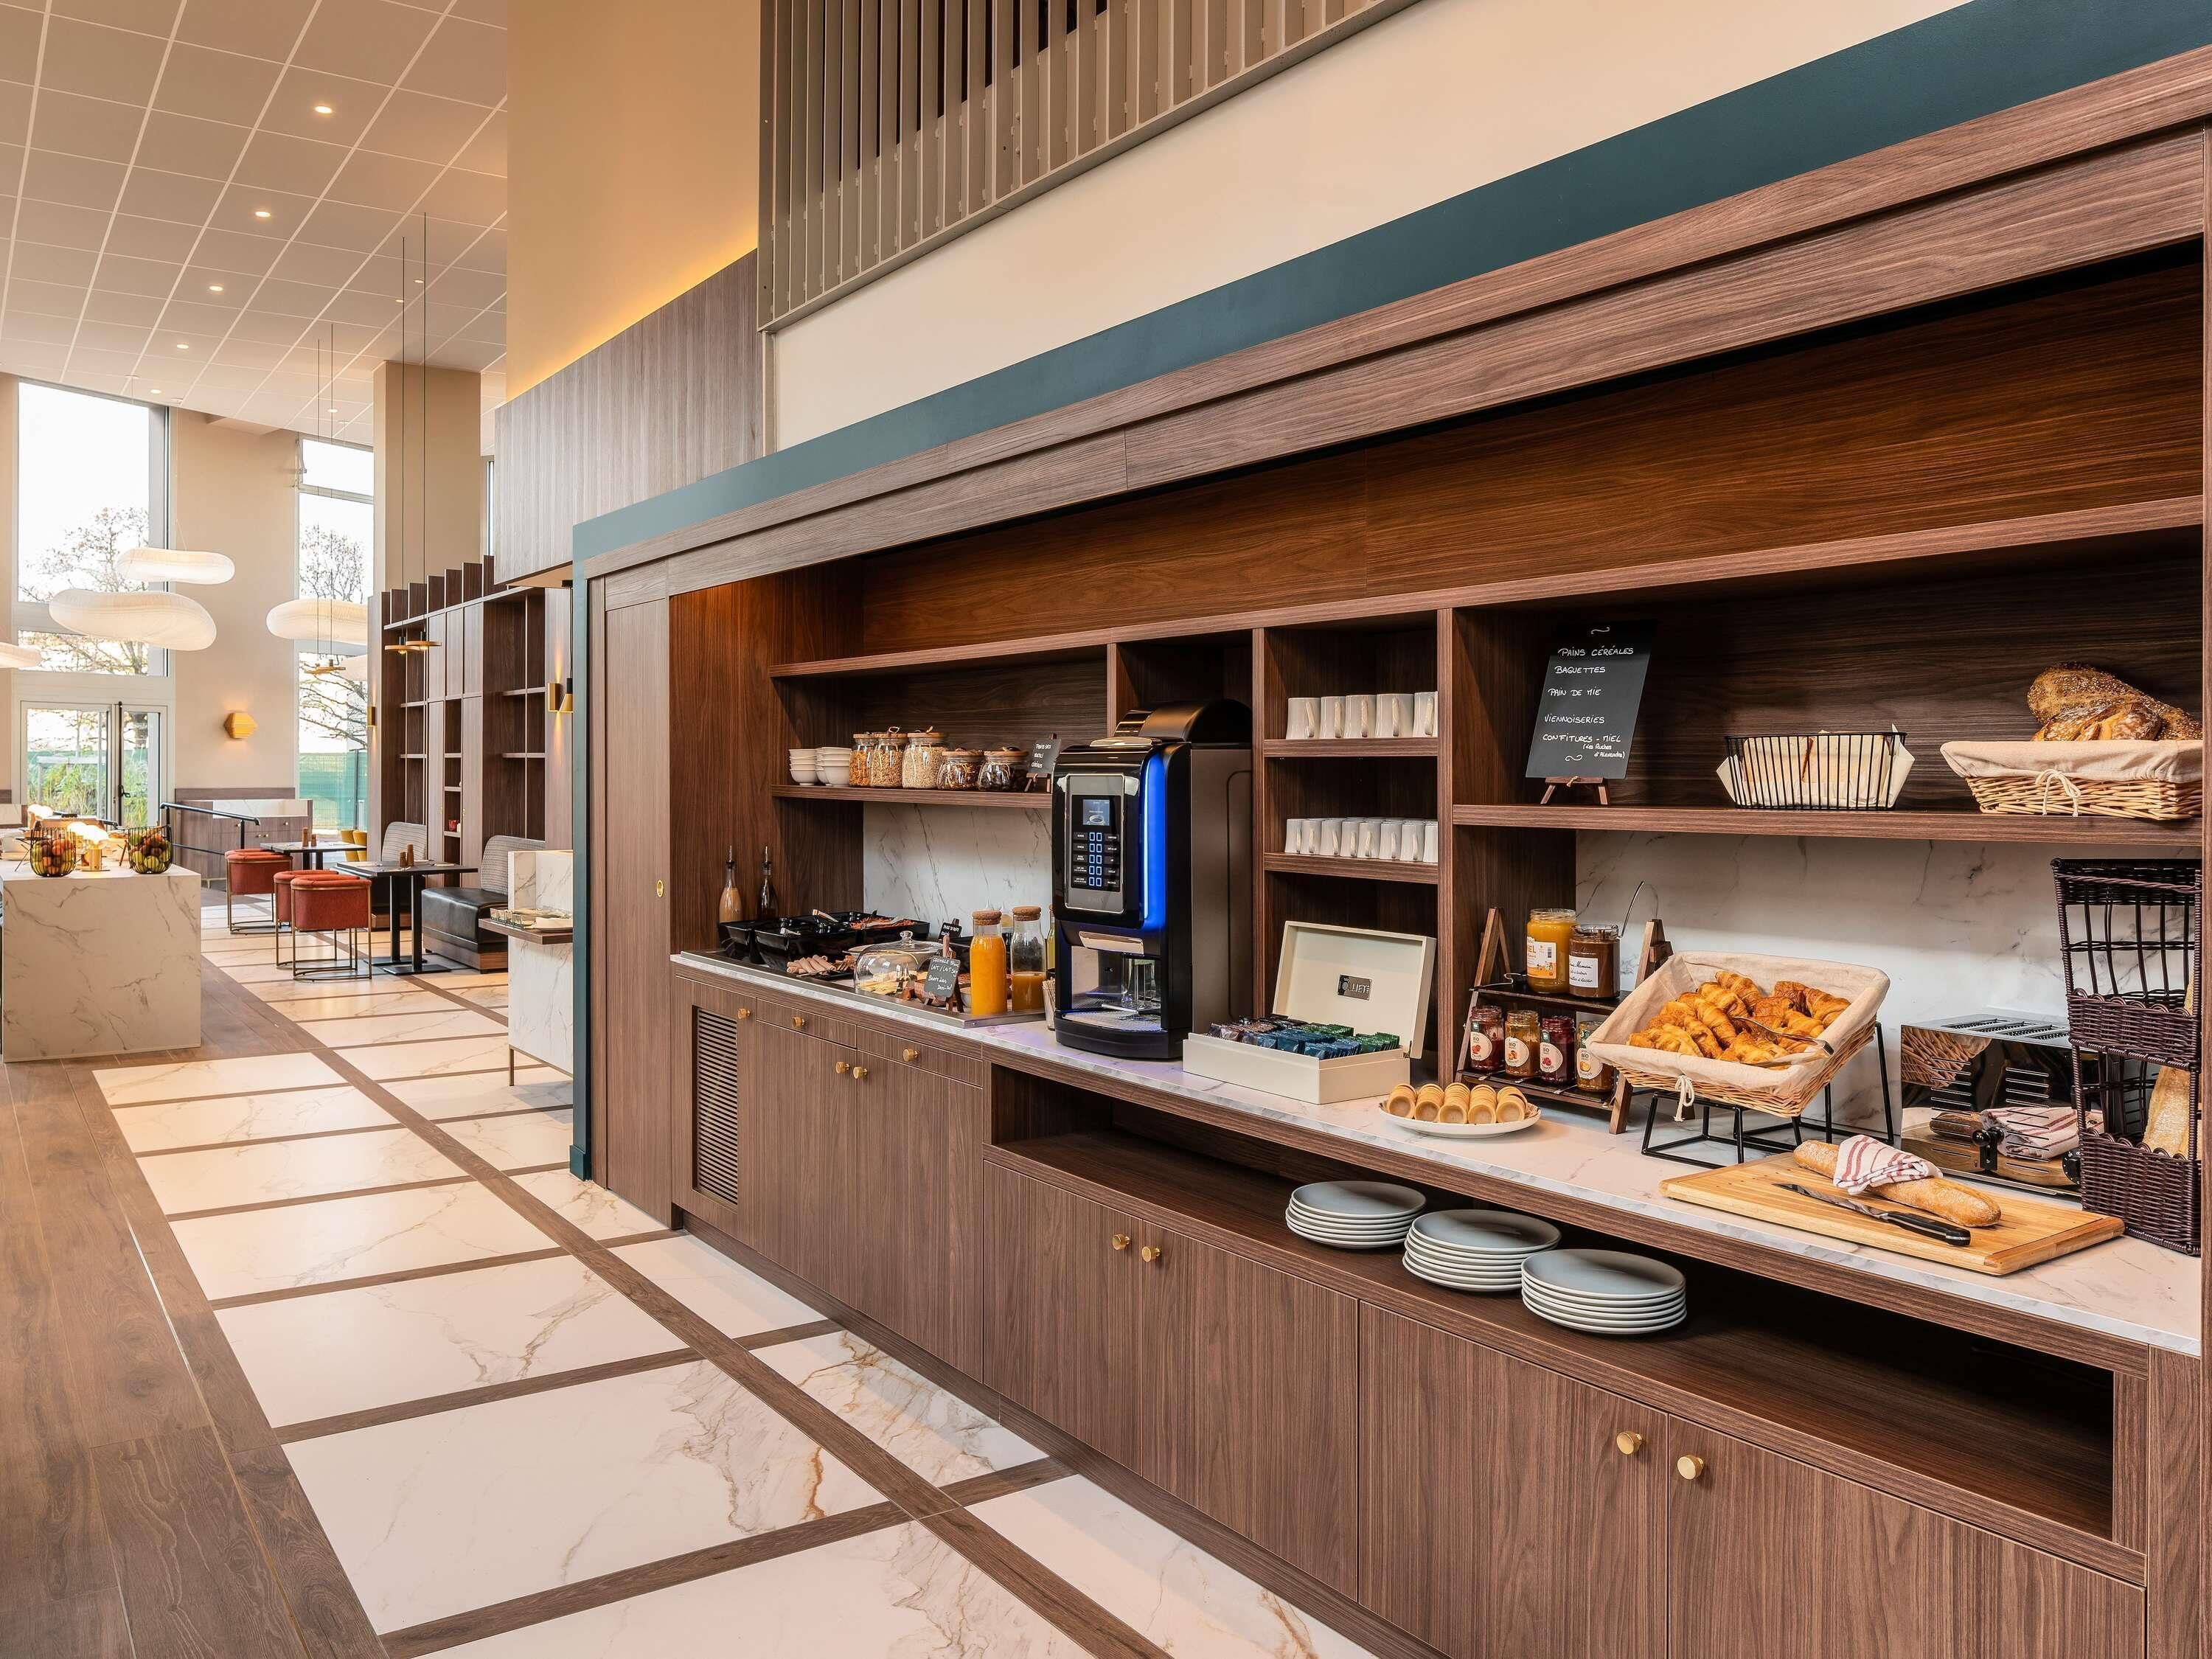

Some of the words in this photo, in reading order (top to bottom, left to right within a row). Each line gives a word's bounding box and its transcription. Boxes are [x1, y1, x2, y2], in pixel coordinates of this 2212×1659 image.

[1591, 645, 1634, 656] CÉRÉALES
[1554, 666, 1606, 674] BAGUETTES
[1548, 687, 1567, 696] PAIN
[1545, 714, 1605, 723] VIENNOISERIES
[1543, 733, 1593, 743] CONFITURES
